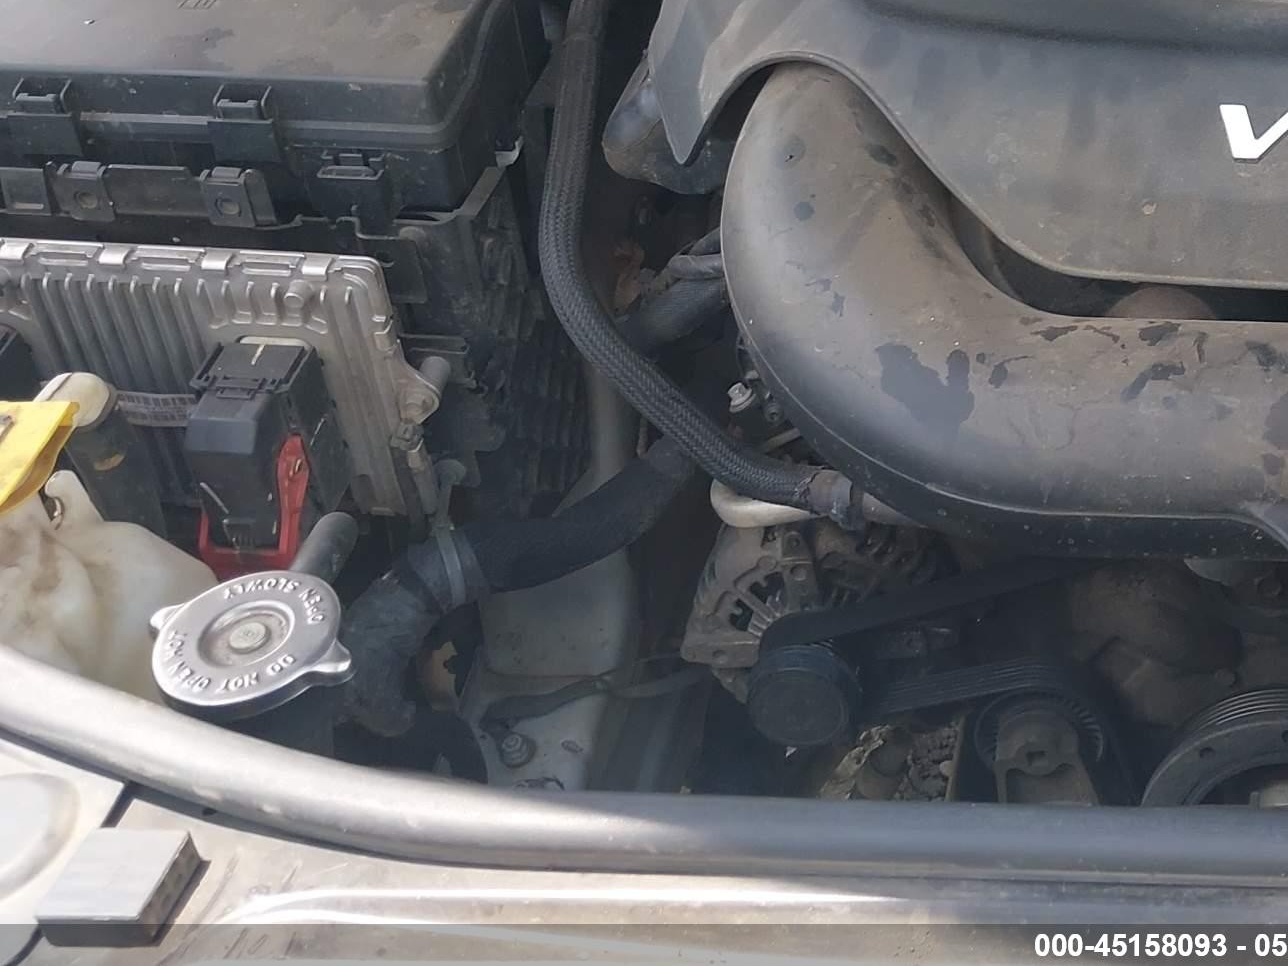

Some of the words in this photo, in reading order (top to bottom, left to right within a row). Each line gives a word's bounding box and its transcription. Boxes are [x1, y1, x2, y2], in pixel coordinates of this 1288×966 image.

[223, 577, 300, 599] SLOWLY
[298, 587, 325, 624] OPEN
[266, 653, 296, 674] DO
[167, 661, 211, 692] OPEN
[215, 672, 259, 694] NOT
